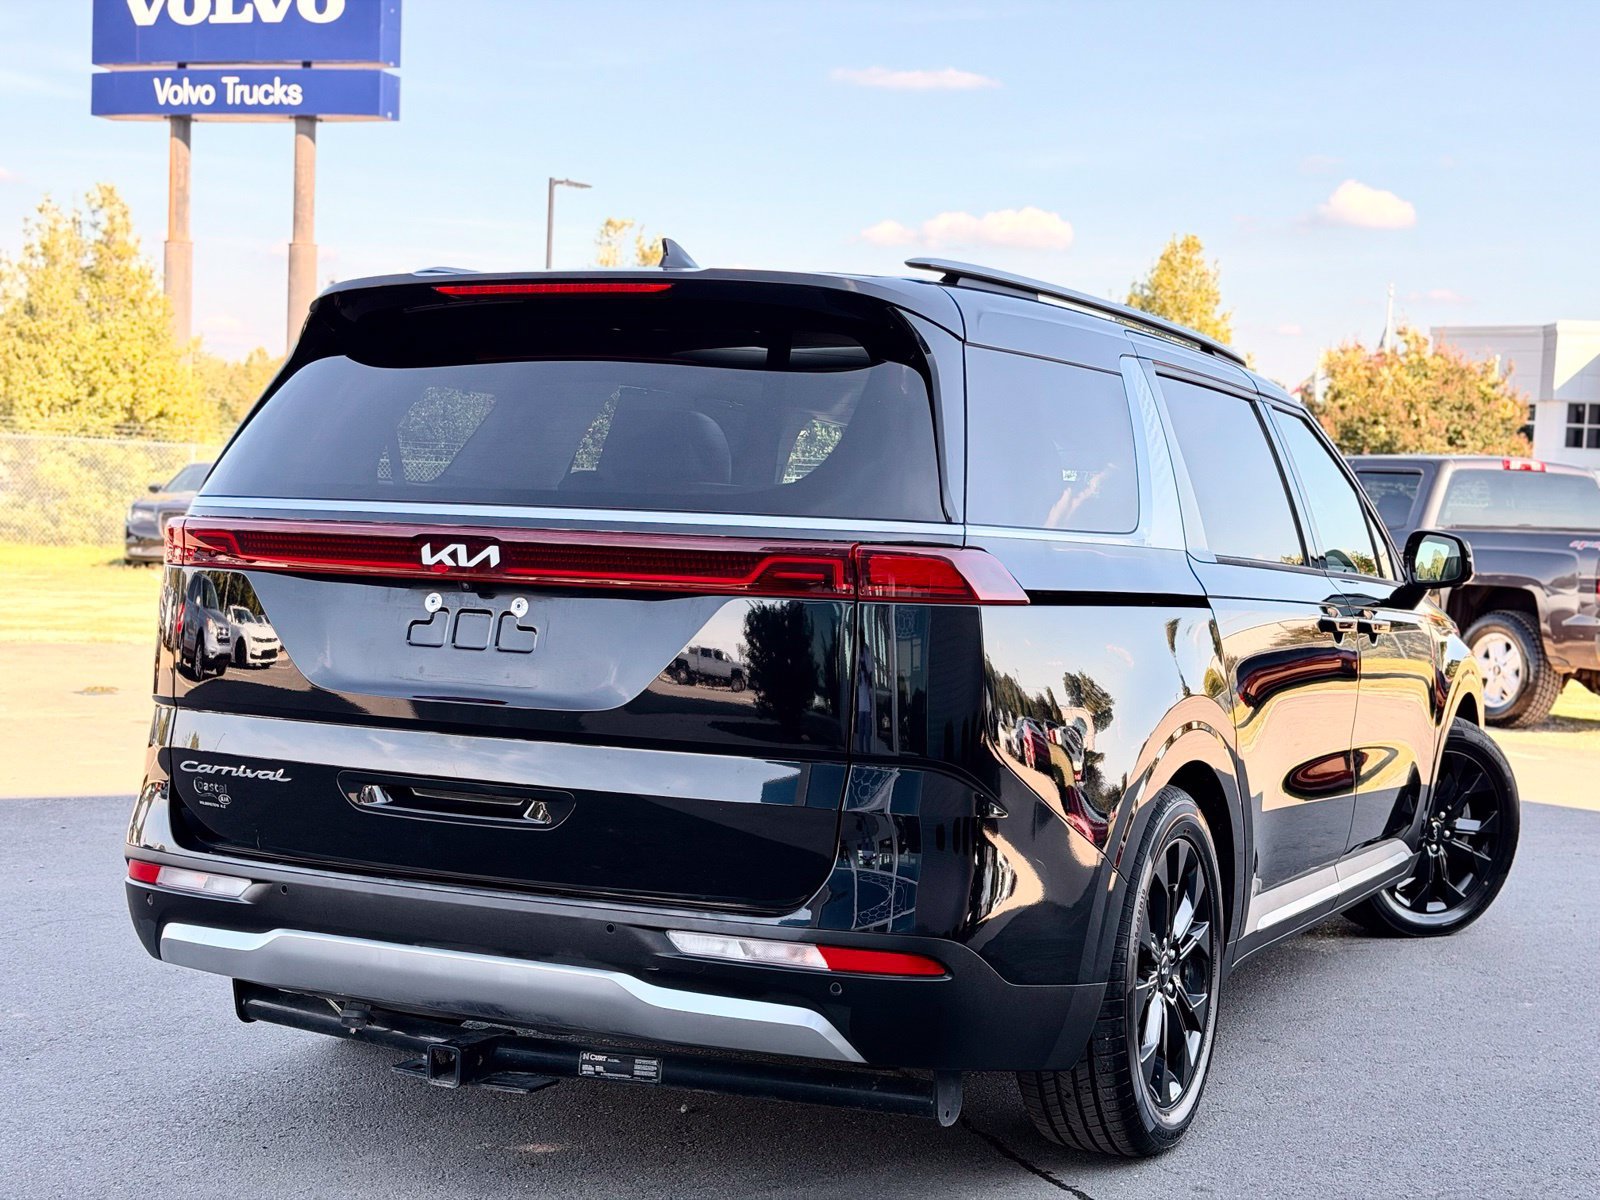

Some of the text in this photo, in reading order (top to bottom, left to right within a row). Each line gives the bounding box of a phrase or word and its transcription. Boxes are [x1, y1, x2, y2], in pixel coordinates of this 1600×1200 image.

[153, 76, 303, 105] Volvo Trucks
[421, 543, 500, 568] KIA
[180, 760, 292, 782] Carnival
